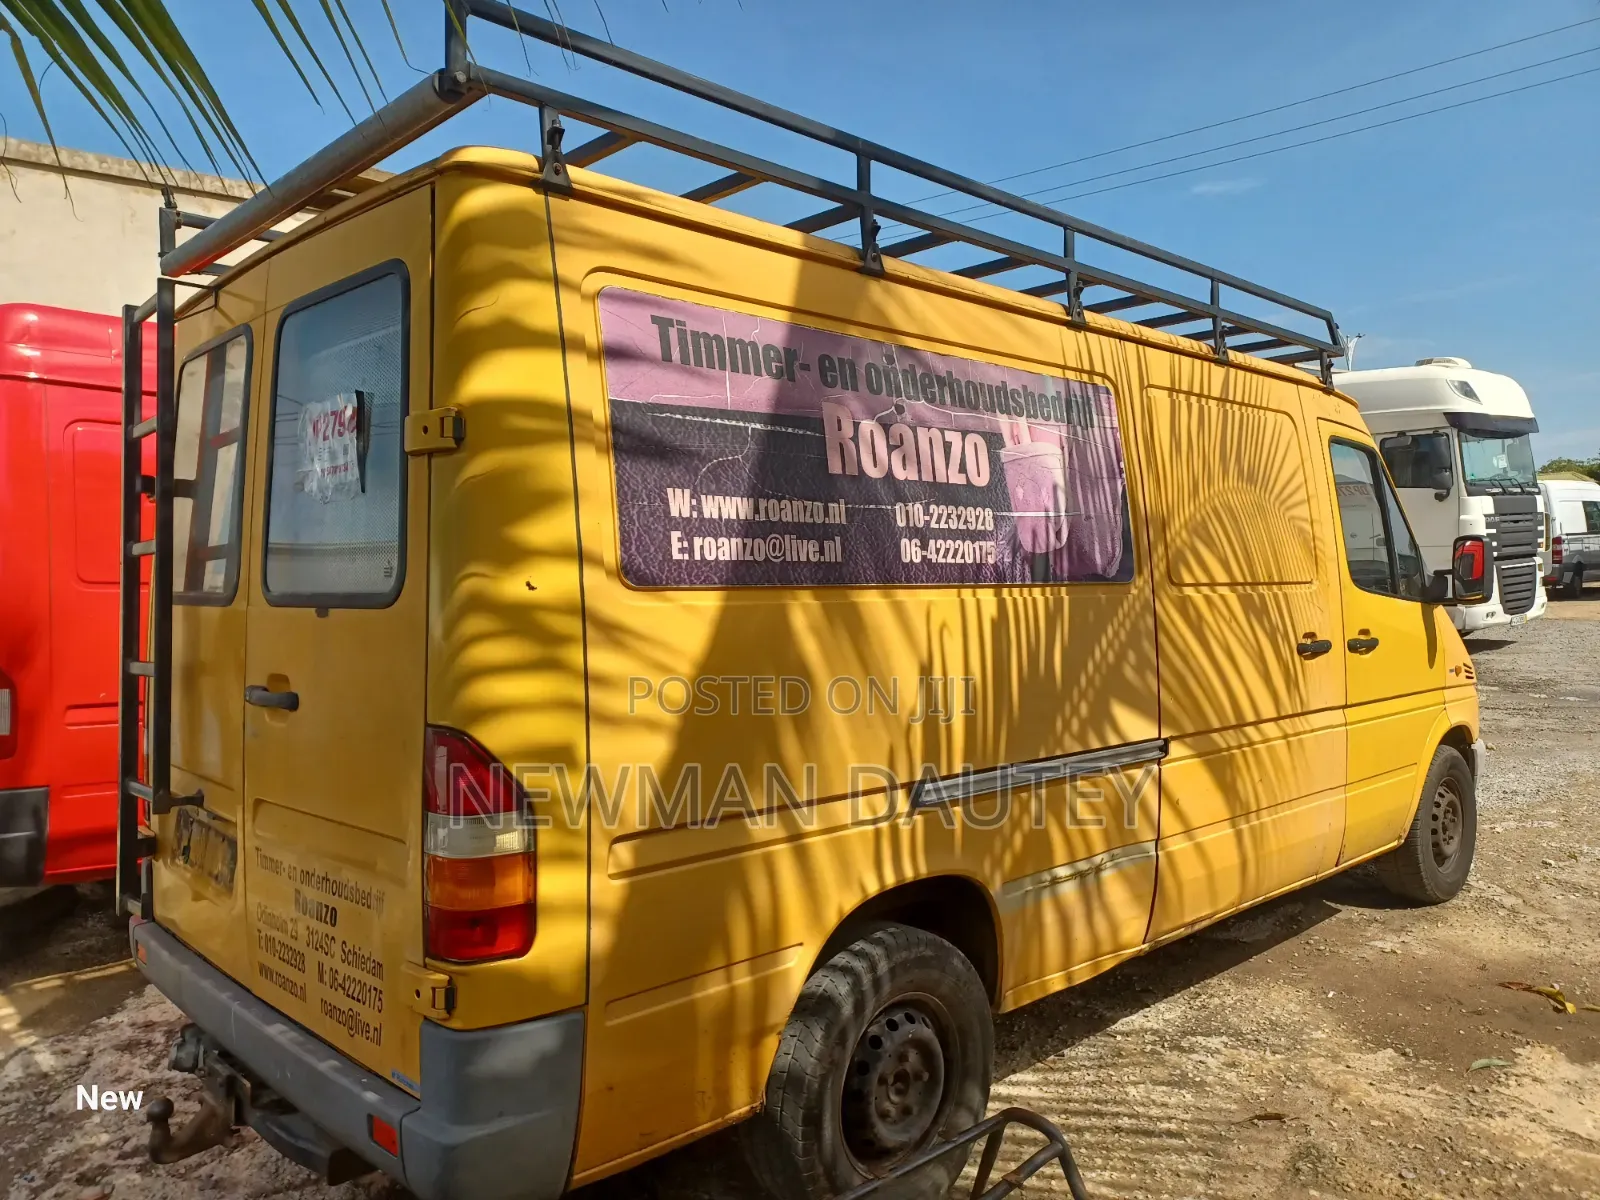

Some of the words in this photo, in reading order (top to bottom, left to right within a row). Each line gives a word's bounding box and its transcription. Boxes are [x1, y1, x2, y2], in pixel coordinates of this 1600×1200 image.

[650, 314, 811, 383] Timmer-
[817, 353, 860, 393] en
[865, 362, 1095, 430] onderhoudsbedrijf
[821, 401, 991, 487] Roanzo
[666, 487, 698, 518] W:
[700, 494, 847, 525] www.roanzo.nl
[895, 502, 994, 532] 010-2232928
[670, 530, 689, 560] E:
[693, 533, 843, 562] roanzo@live.nl
[900, 538, 997, 564] 06-42220175
[255, 846, 286, 877] Timmer-
[287, 863, 298, 883] en
[294, 887, 338, 928] Roanzo
[264, 932, 306, 974] 010-2232928
[305, 924, 336, 959] 3124SC
[340, 940, 384, 982] Schiedam
[257, 960, 307, 1004] www.roanzo.nl
[317, 960, 327, 987] M:
[328, 966, 384, 1014] 06-42220175
[320, 997, 383, 1047] roanzo@live.nl
